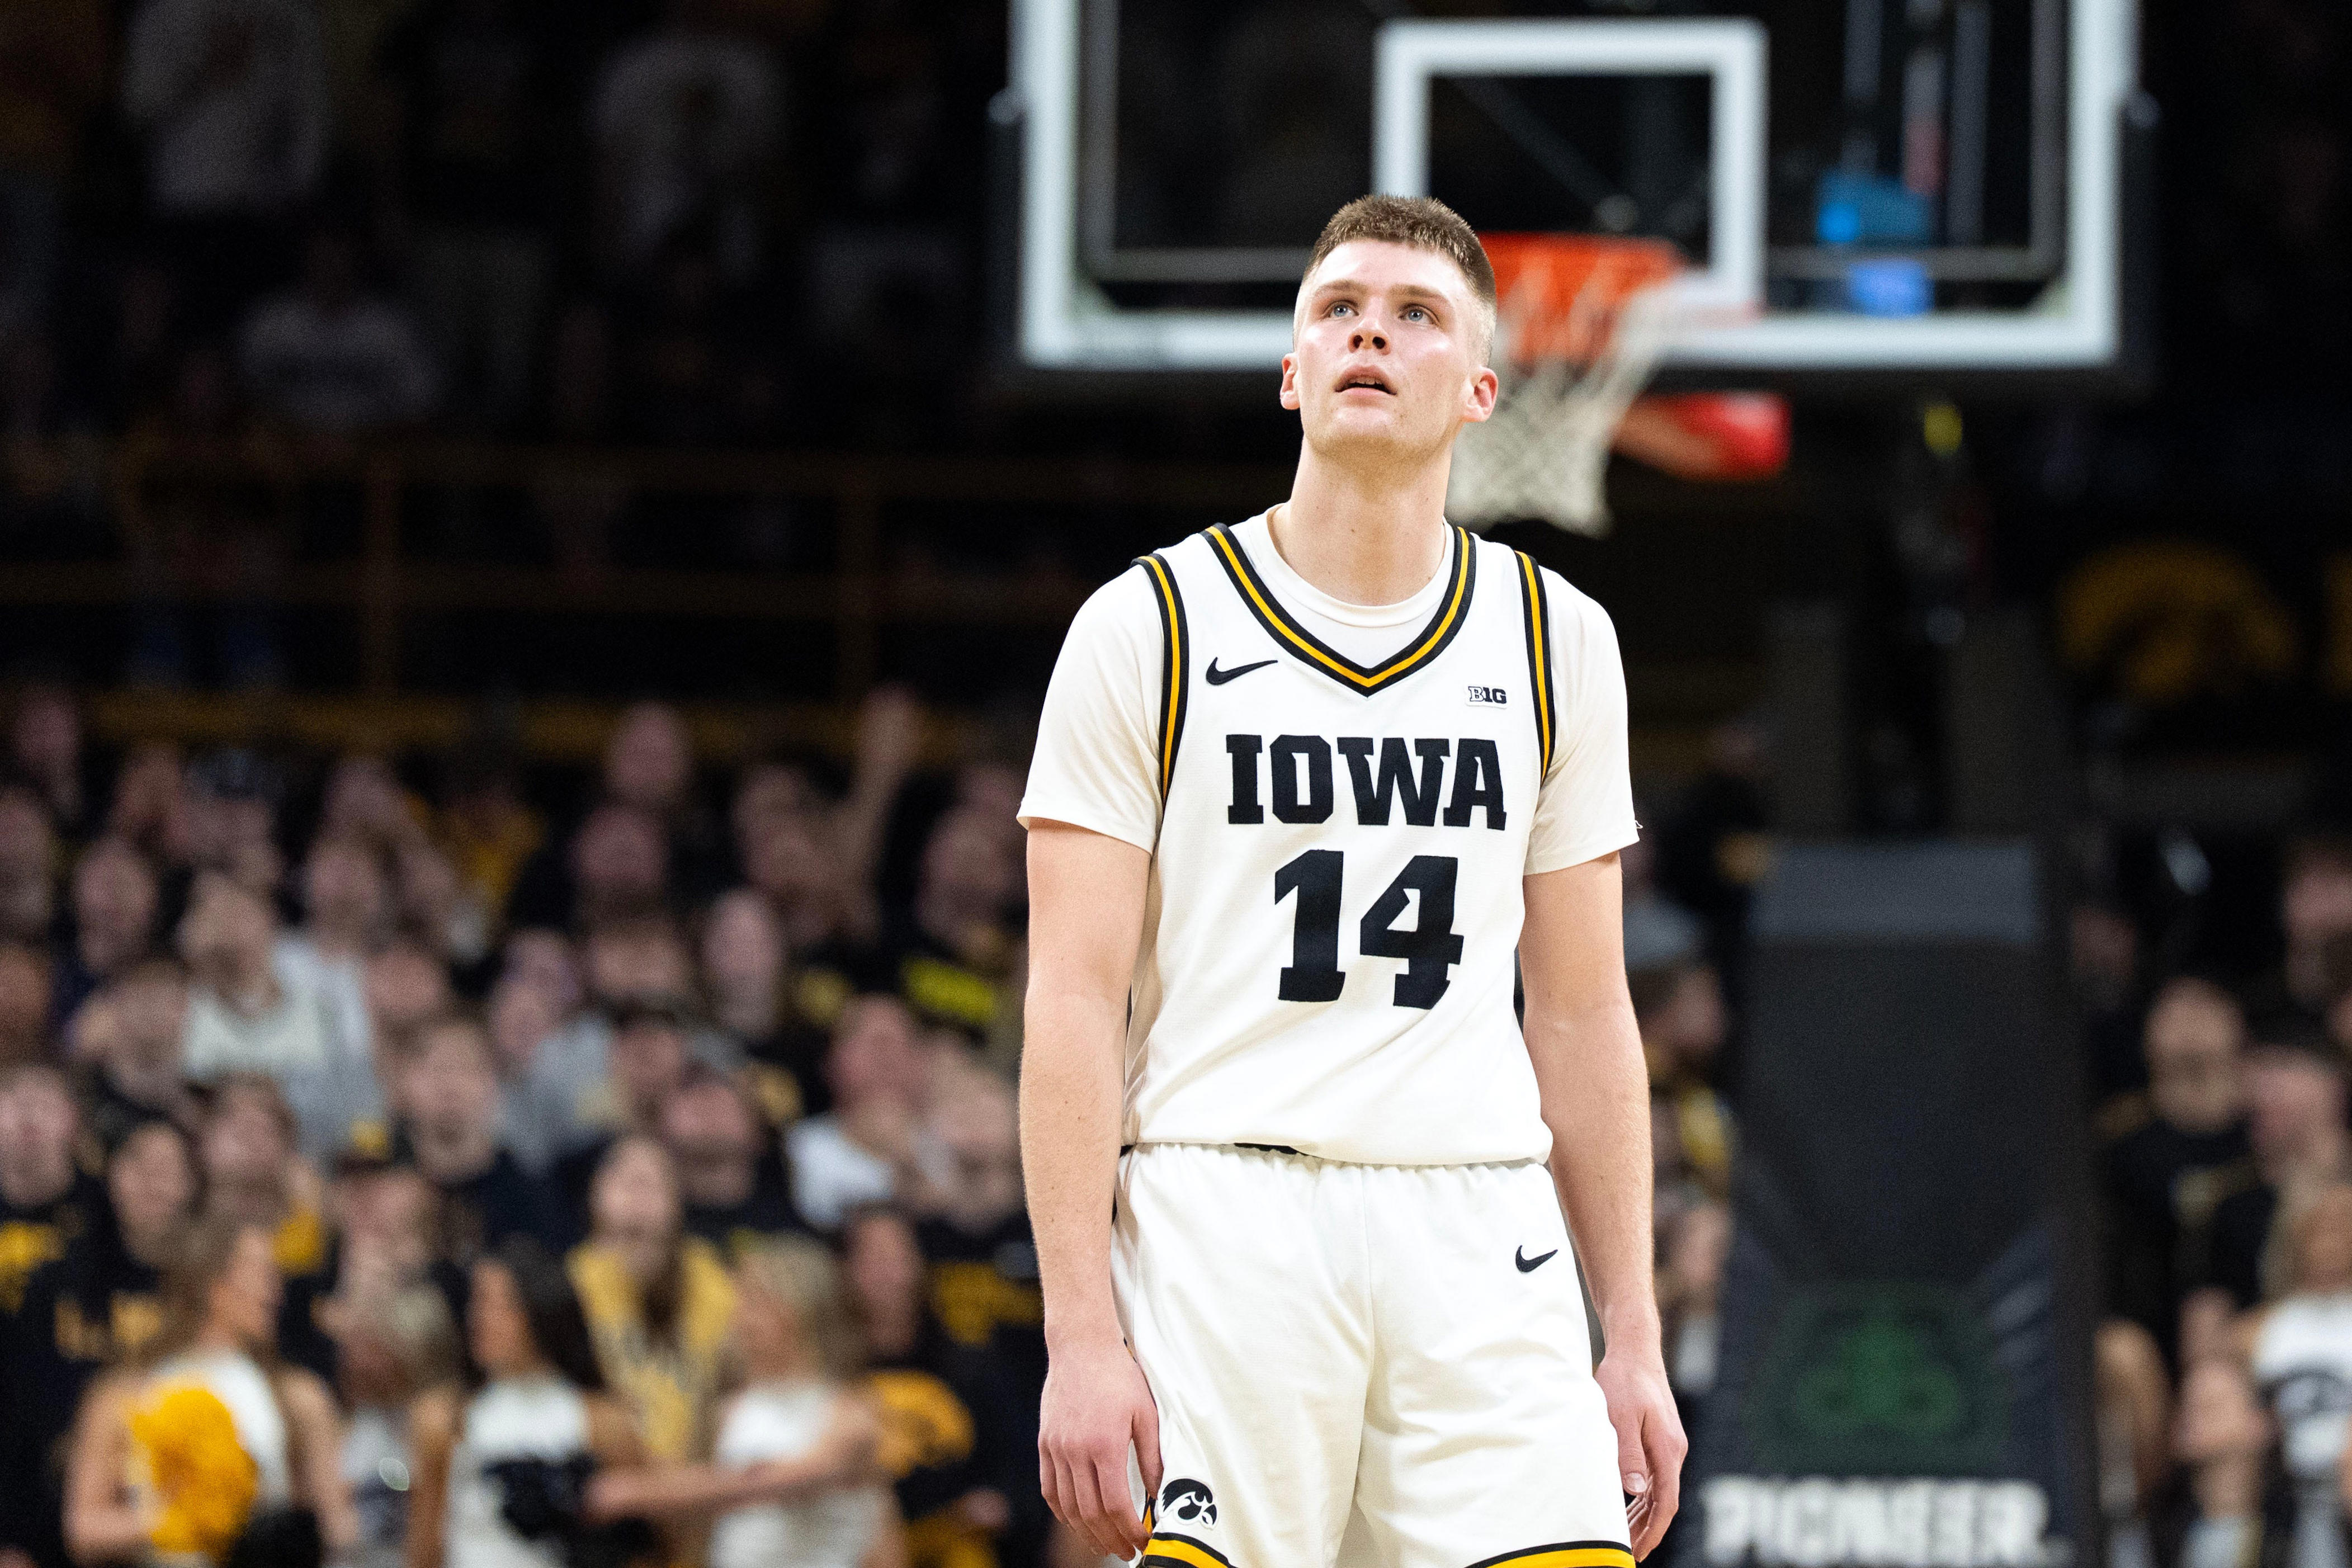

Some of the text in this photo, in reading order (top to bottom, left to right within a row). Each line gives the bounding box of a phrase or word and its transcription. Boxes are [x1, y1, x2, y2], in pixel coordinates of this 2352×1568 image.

[1468, 686, 1506, 704] BIG
[1226, 734, 1507, 831] IOWA
[1274, 849, 1464, 1010] 14
